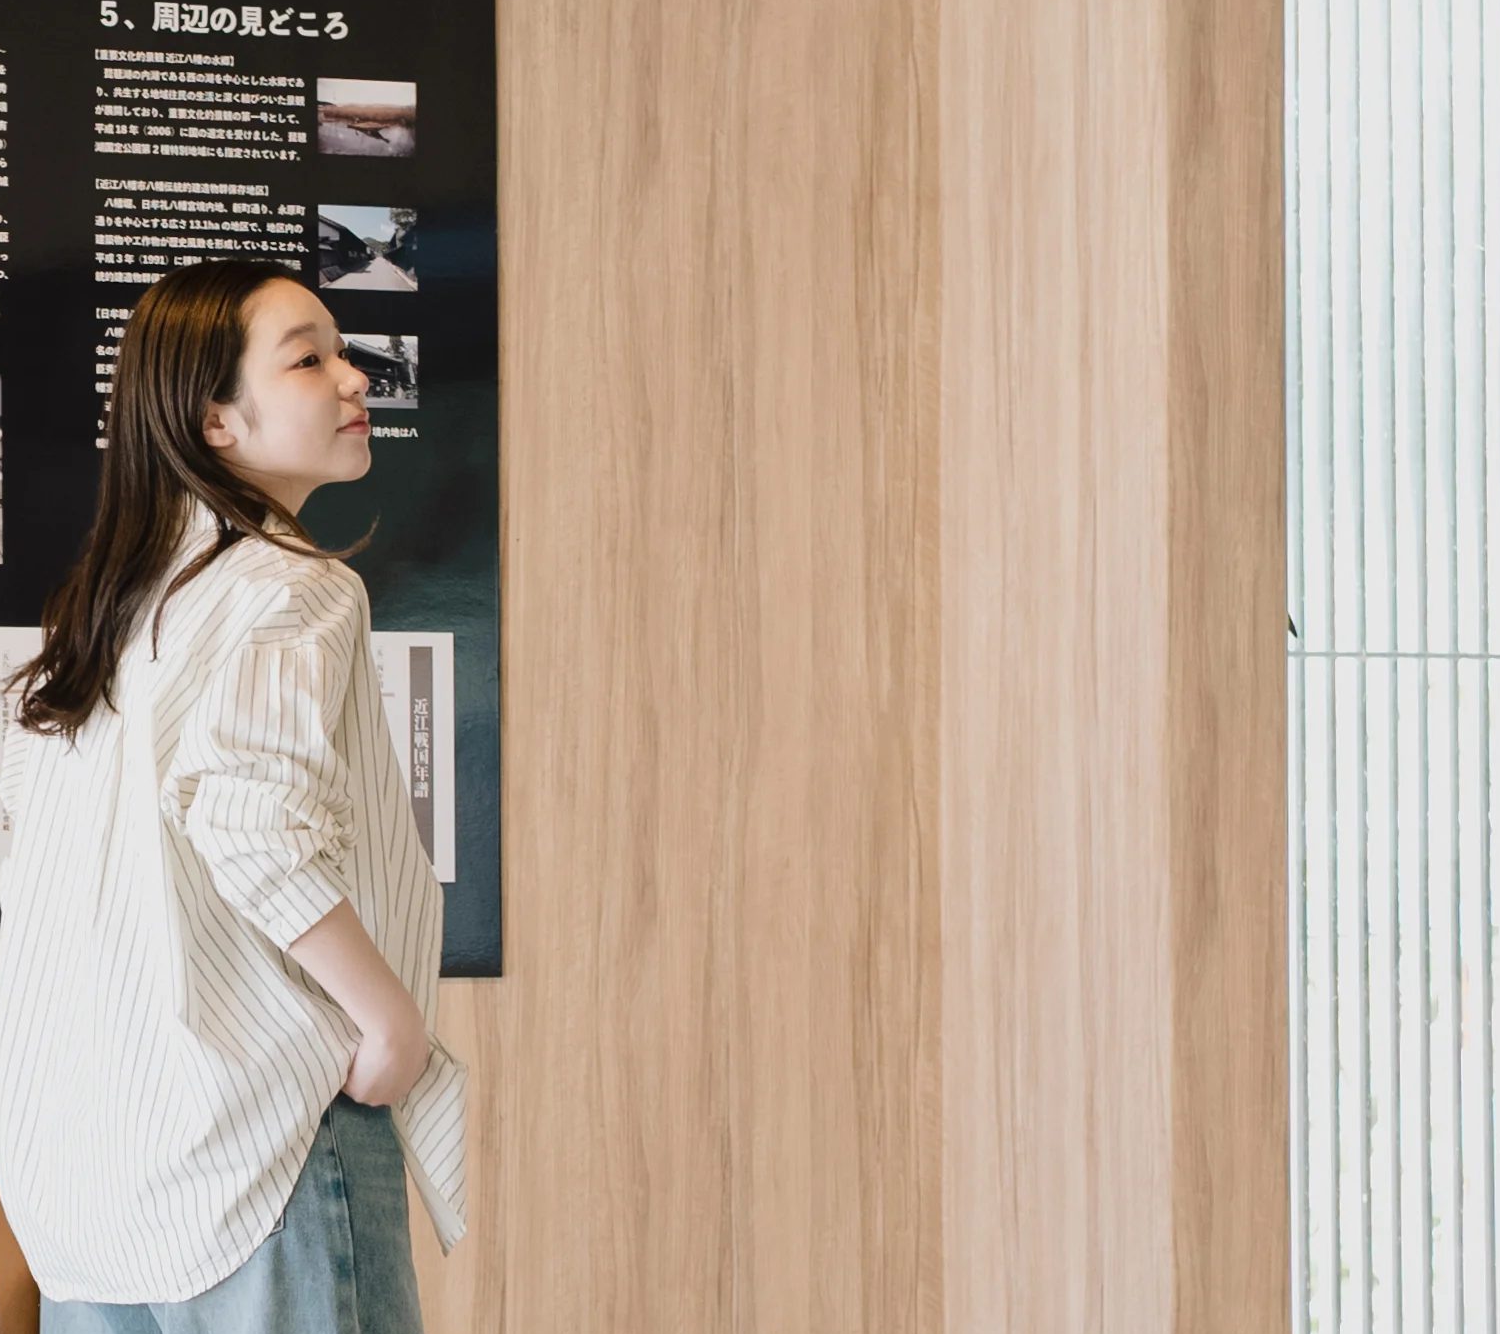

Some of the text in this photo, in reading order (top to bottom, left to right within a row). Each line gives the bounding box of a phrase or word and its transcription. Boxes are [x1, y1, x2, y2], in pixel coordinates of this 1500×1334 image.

[99, 0, 349, 39] 5、周辺の見どころ
[413, 698, 429, 798] 近江戦国年譜
